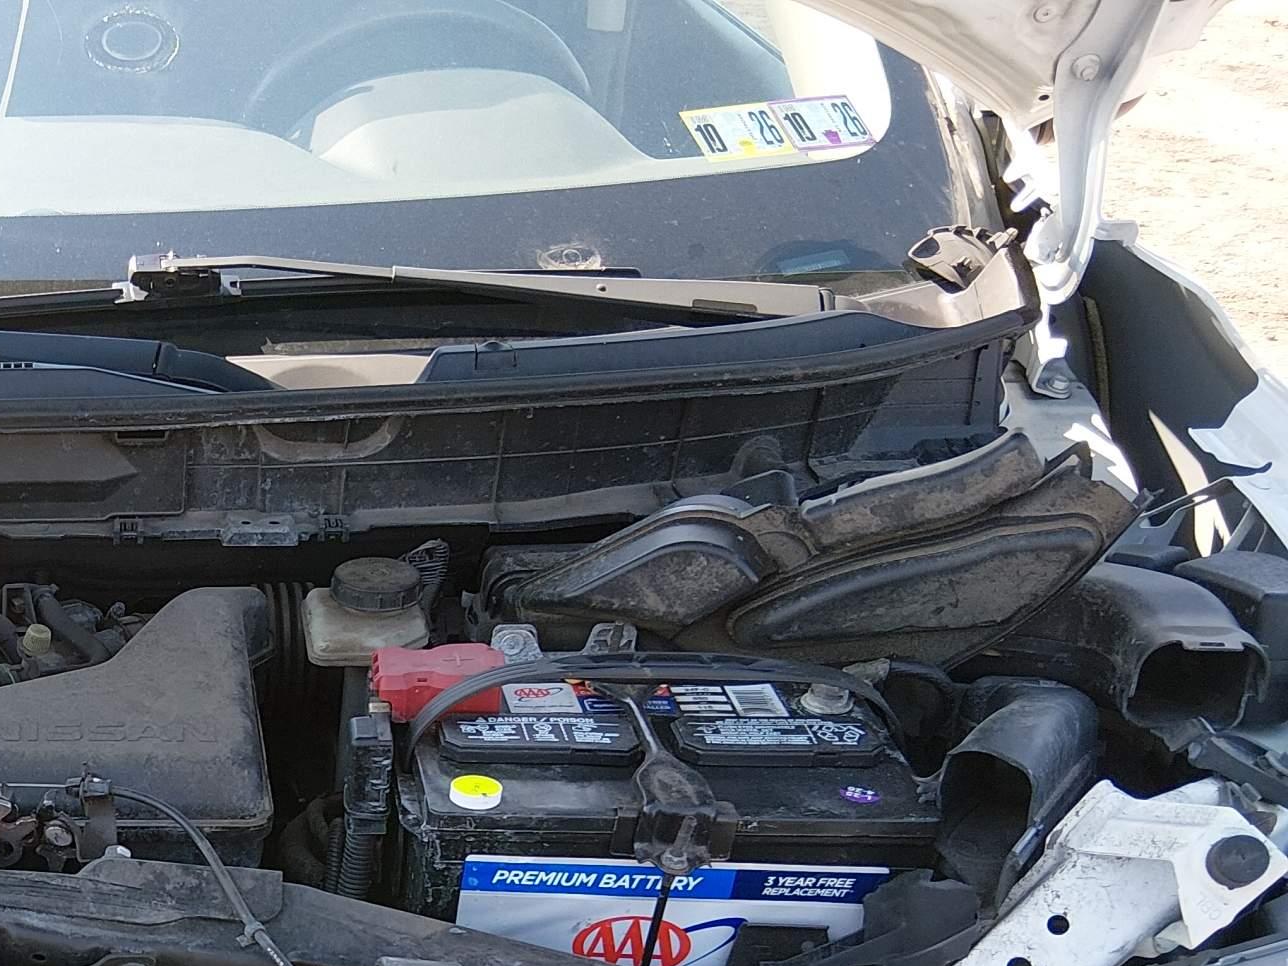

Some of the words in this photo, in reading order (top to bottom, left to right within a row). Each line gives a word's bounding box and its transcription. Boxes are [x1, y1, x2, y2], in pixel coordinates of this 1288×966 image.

[748, 110, 785, 145] 26
[831, 102, 868, 137] 26
[514, 687, 551, 699] AAA
[492, 869, 598, 887] PREMIUM
[764, 876, 777, 886] 3
[777, 876, 816, 887] YEAR
[816, 878, 856, 888] FREE
